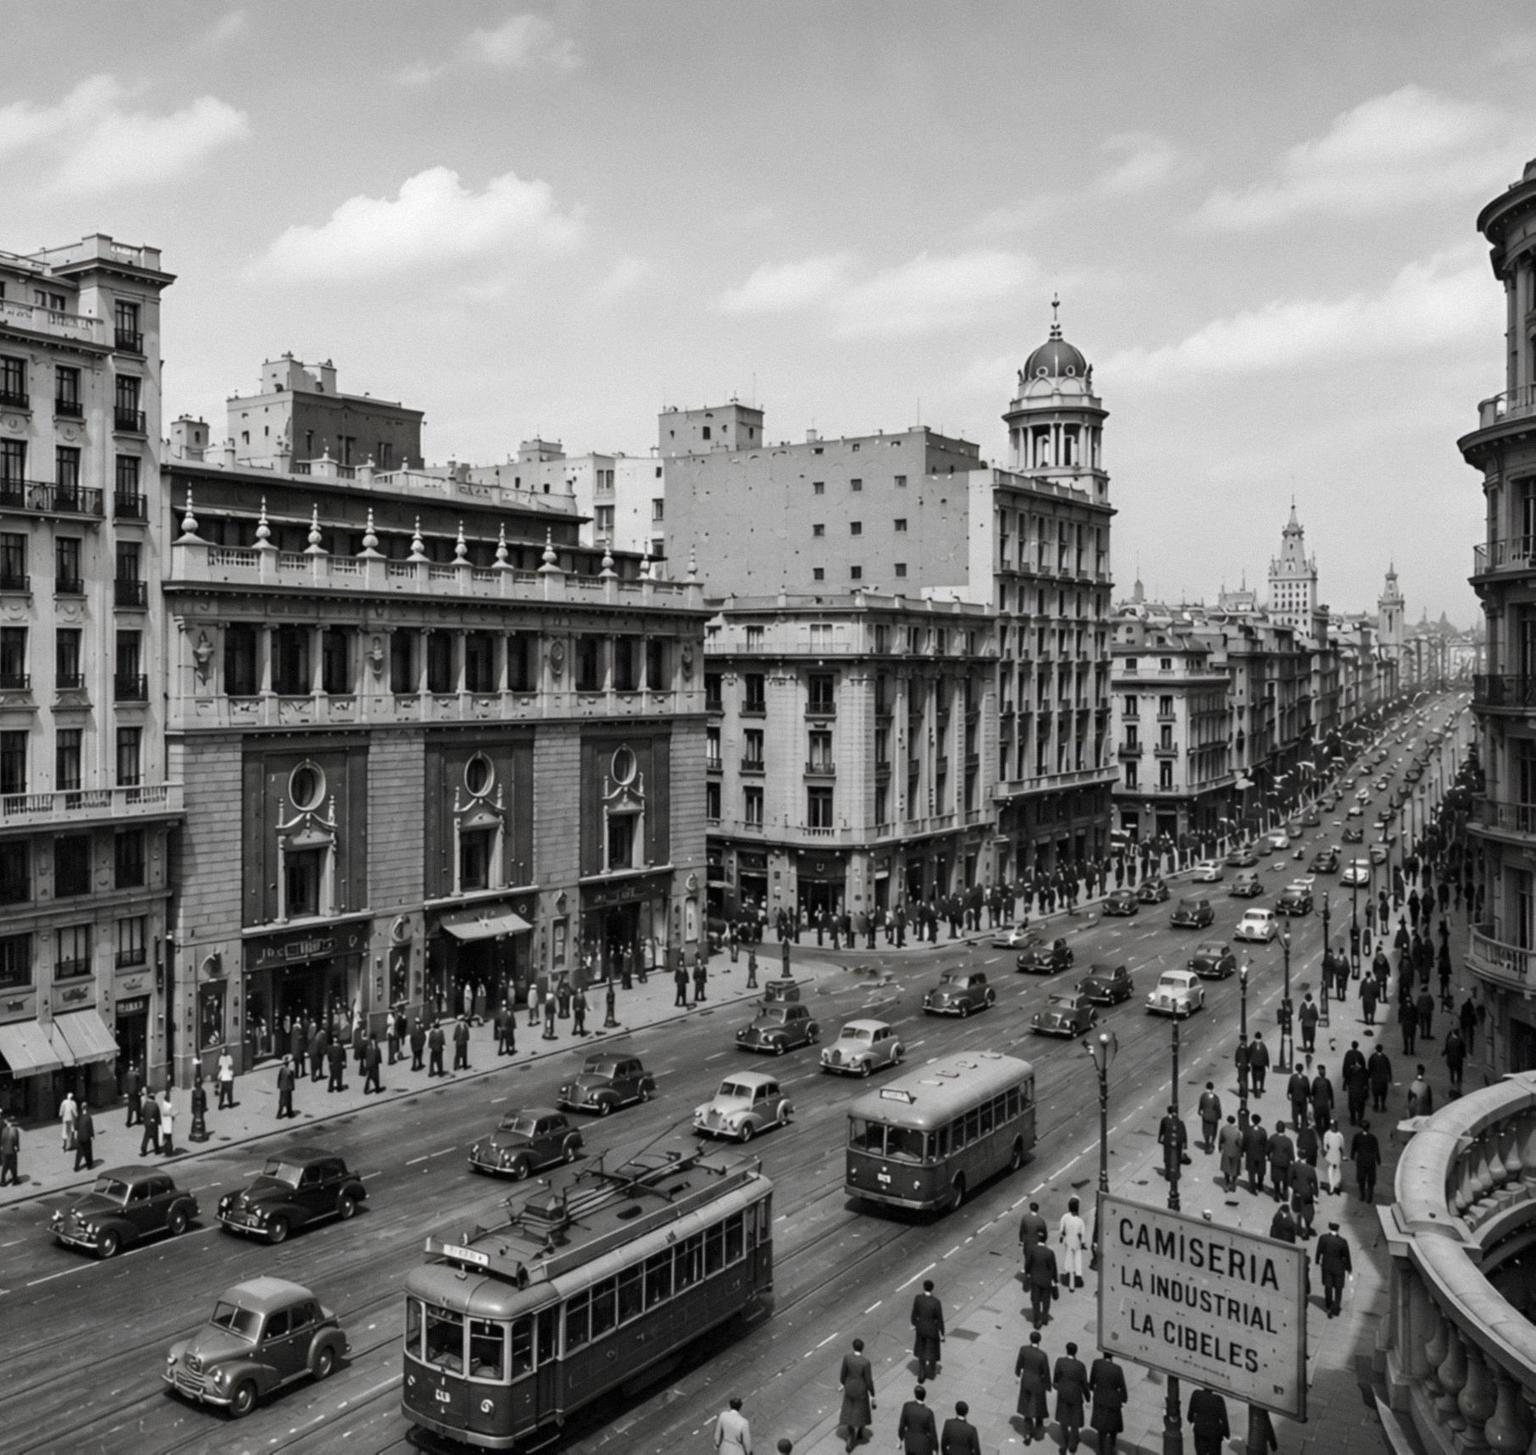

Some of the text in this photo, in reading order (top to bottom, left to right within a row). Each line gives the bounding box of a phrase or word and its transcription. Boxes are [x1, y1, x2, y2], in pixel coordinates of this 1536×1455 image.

[1119, 1218, 1280, 1291] CAMISERIA
[1121, 1265, 1278, 1335] LA INDUSTRIAL
[1130, 1308, 1156, 1338] LA
[1163, 1319, 1259, 1374] CIBELES
